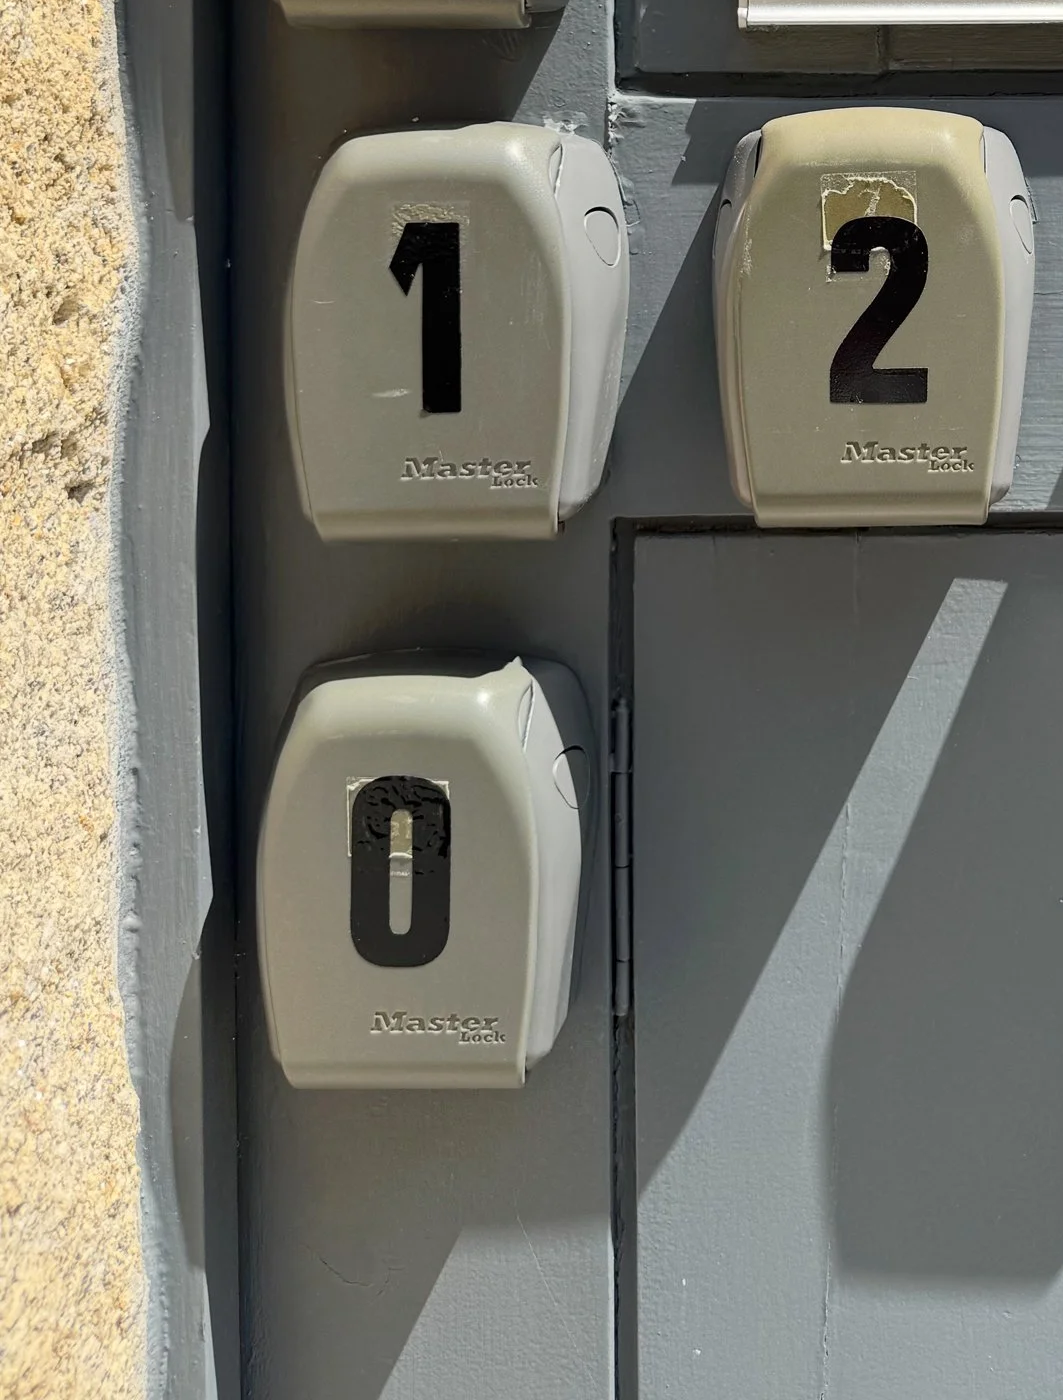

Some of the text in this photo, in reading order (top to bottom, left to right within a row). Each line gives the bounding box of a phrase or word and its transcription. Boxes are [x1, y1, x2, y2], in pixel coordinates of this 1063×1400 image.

[389, 223, 461, 413] 1
[830, 216, 928, 403] 2
[840, 441, 968, 464] Master
[400, 456, 532, 480] Master
[927, 459, 974, 472] Lock
[490, 474, 538, 489] Lock
[351, 775, 451, 967] 0
[370, 1011, 499, 1034] Master
[458, 1031, 506, 1044] Lock
